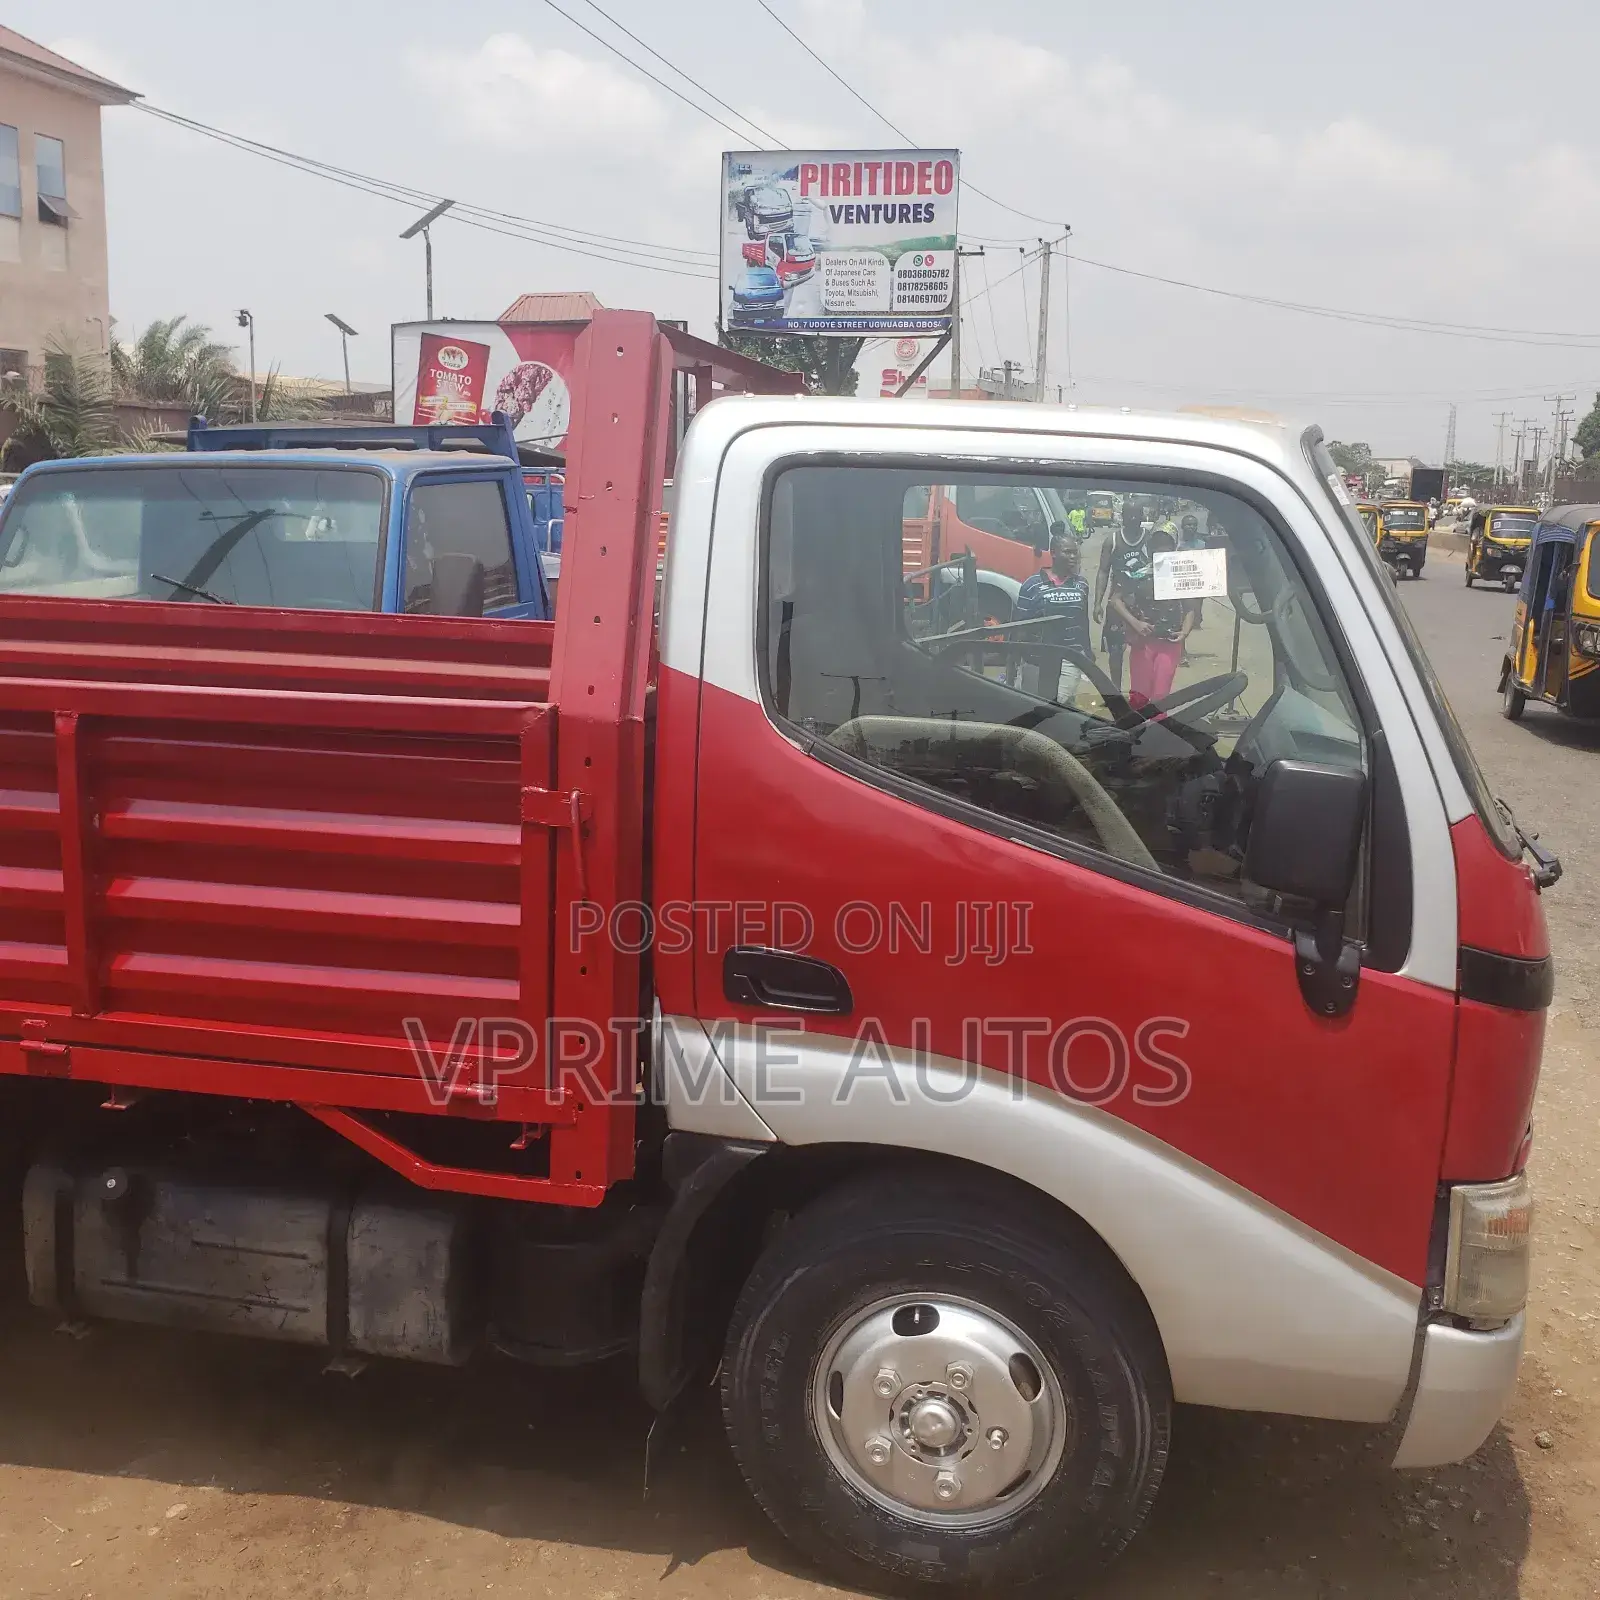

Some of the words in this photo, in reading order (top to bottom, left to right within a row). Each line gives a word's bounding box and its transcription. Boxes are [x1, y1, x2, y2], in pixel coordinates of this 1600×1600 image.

[800, 160, 954, 197] PIRITIDEO
[829, 203, 935, 224] VENTURES
[868, 258, 885, 266] Kinds
[834, 269, 861, 278] Japanese
[825, 289, 846, 298] Toyota,
[824, 299, 844, 307] Nissan
[845, 299, 857, 307] etc.
[897, 294, 948, 304] 08140697002
[788, 321, 802, 329] NO.
[430, 368, 472, 386] TOMATO
[436, 379, 465, 393] STEW
